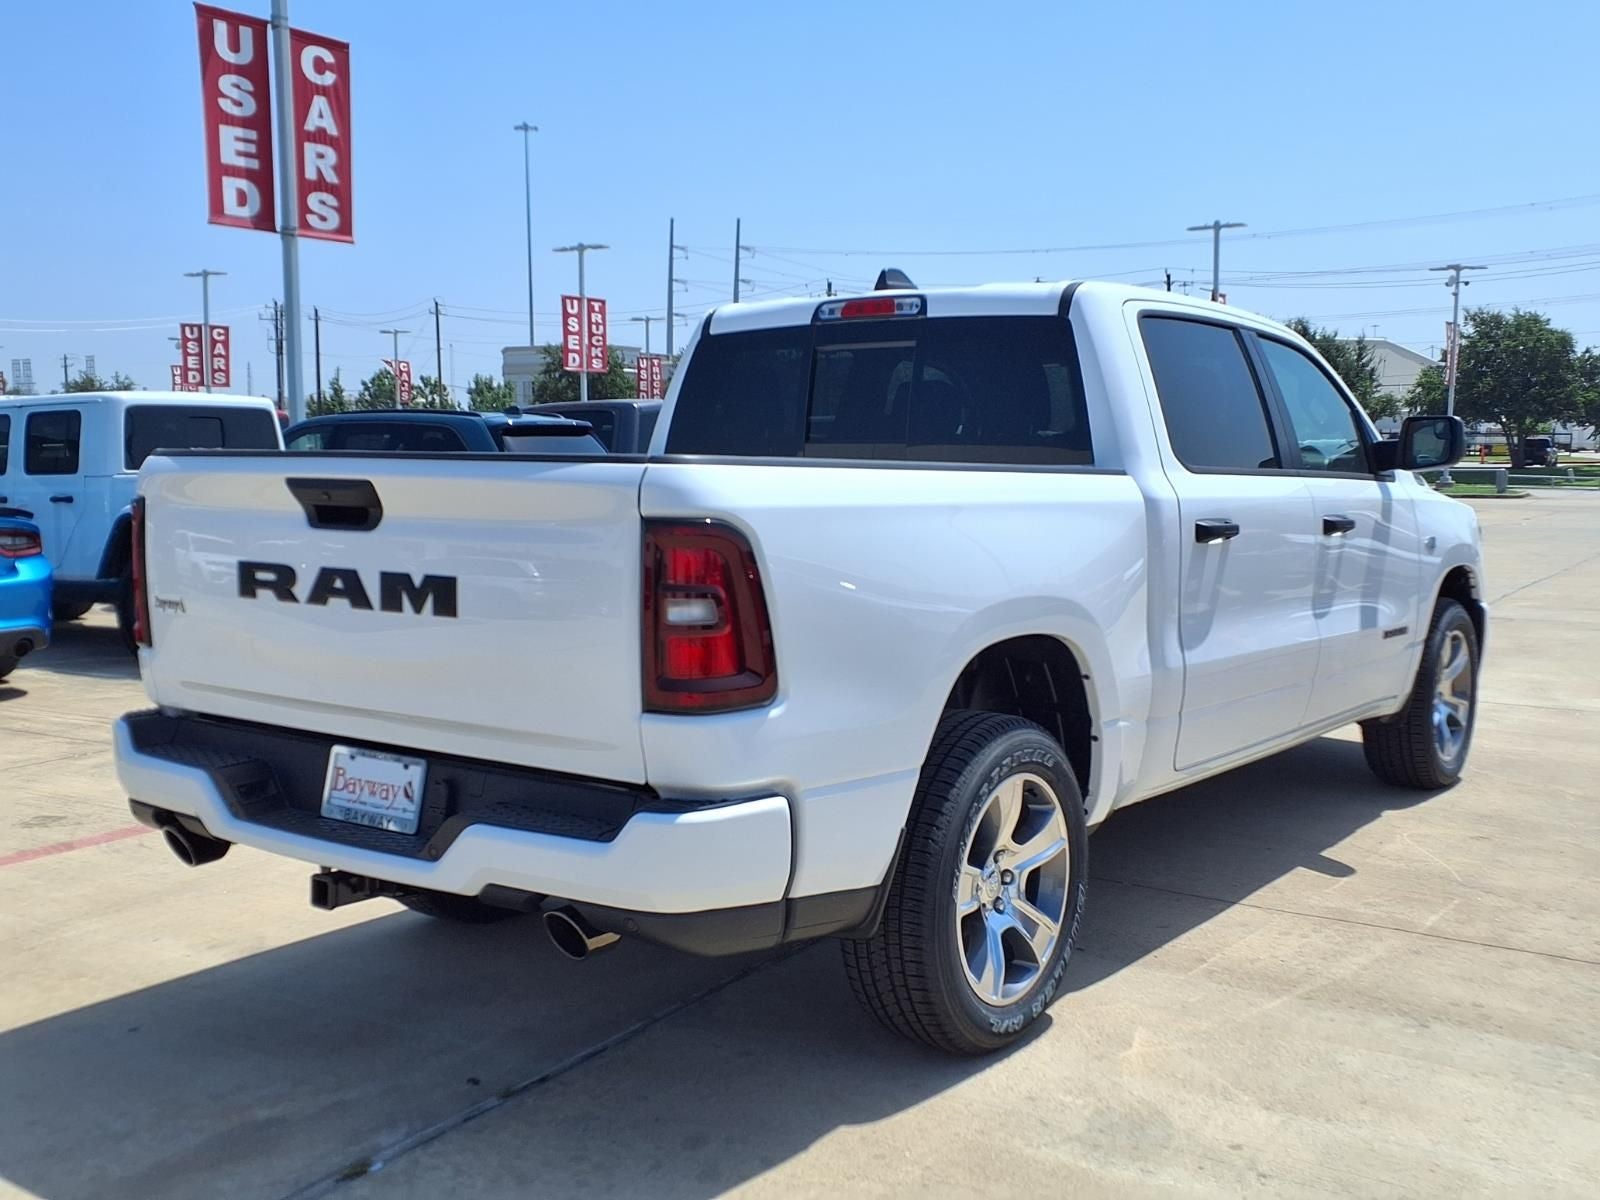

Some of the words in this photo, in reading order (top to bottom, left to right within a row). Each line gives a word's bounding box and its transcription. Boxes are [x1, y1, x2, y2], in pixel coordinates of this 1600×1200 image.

[213, 18, 261, 219] USED
[300, 44, 341, 231] CARS
[184, 326, 201, 384] USED
[212, 328, 227, 384] CARS
[565, 299, 580, 367] USED
[591, 302, 604, 369] TRUCKS
[173, 367, 182, 391] USE
[238, 560, 457, 618] RAM
[332, 766, 400, 809] Bayway
[343, 808, 393, 829] BAYWAY
